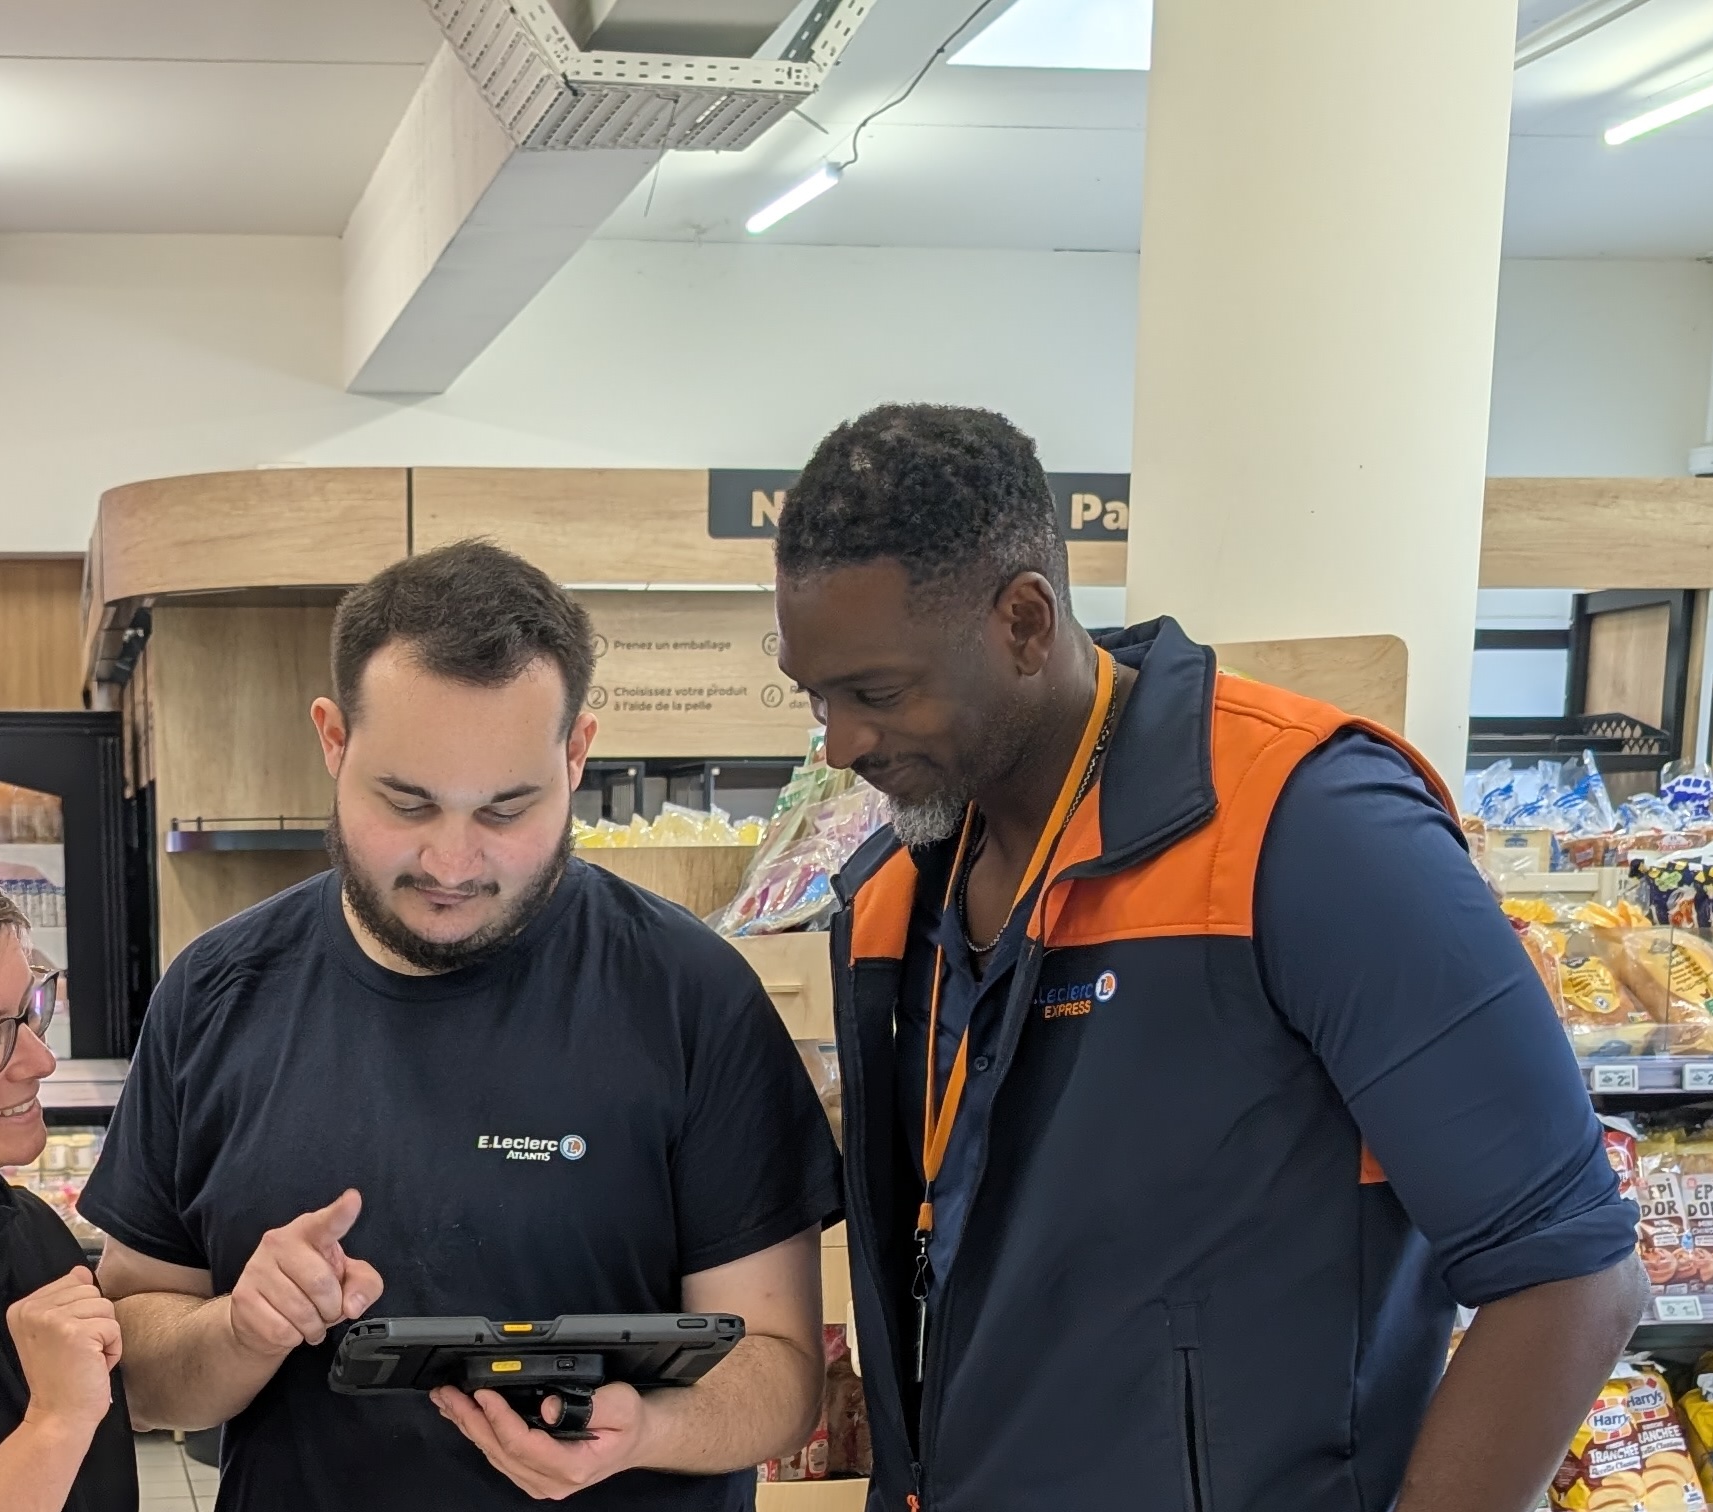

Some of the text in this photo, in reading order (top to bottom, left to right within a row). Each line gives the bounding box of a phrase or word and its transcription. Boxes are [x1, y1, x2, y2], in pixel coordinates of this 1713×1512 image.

[614, 640, 653, 650] Prenez
[655, 641, 670, 650] un
[672, 639, 731, 652] emballage
[614, 686, 672, 697] Choisissez
[675, 687, 705, 697] votre
[707, 685, 747, 699] produit
[655, 700, 670, 711] de
[1044, 1000, 1092, 1018] EXPRESS
[478, 1135, 558, 1151] E.Leclerc
[1589, 1440, 1640, 1465] TRANCHÉE
